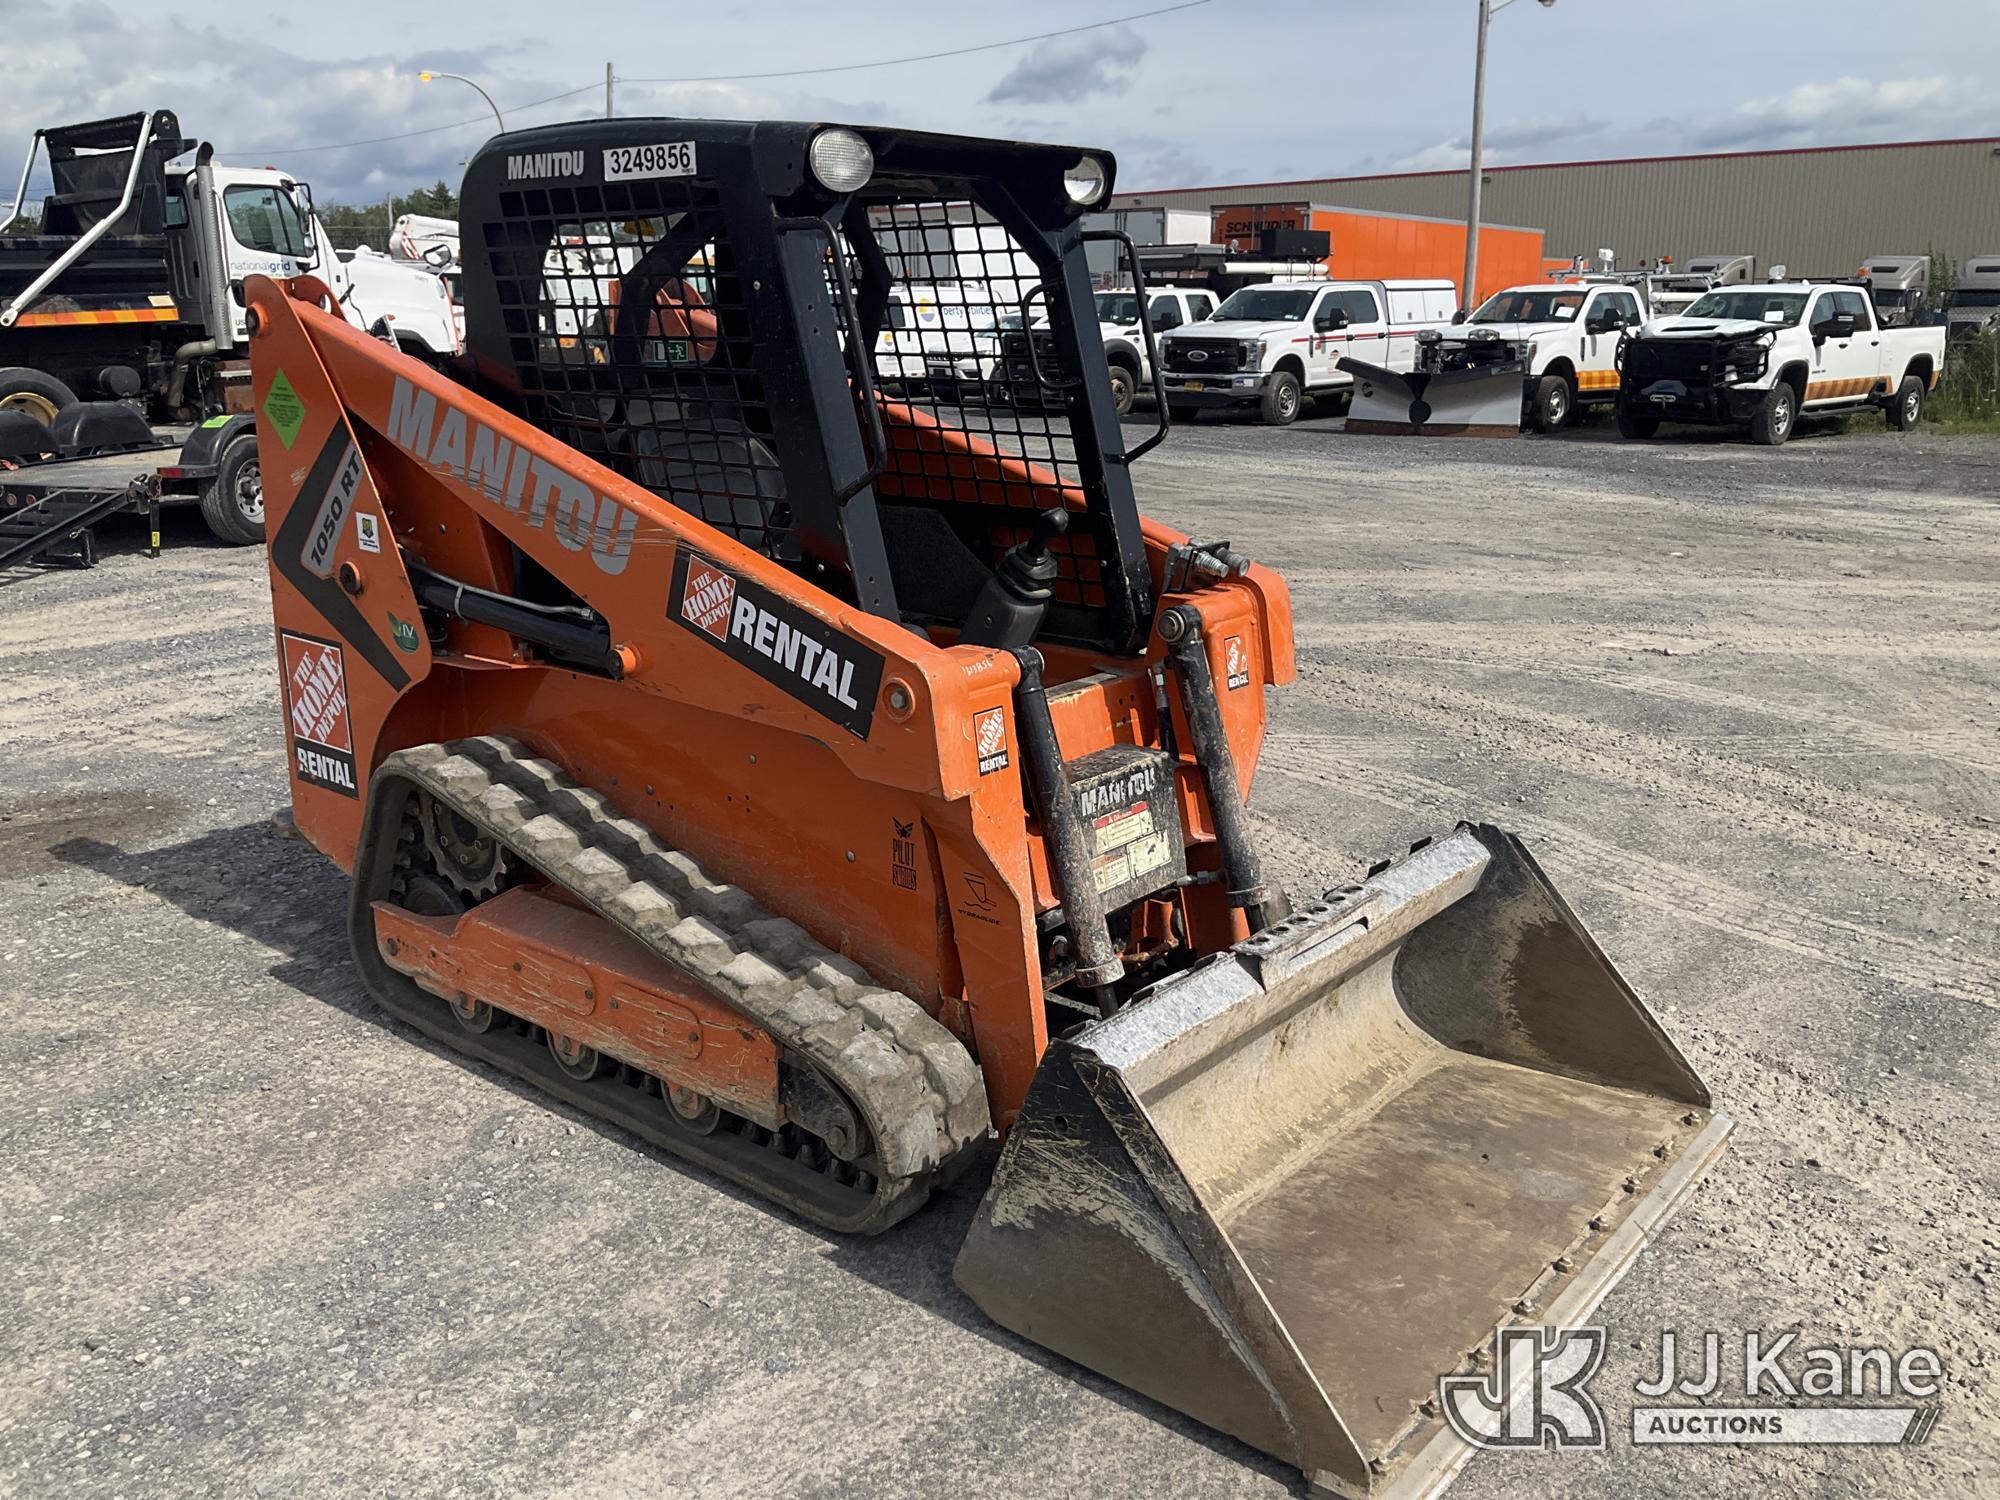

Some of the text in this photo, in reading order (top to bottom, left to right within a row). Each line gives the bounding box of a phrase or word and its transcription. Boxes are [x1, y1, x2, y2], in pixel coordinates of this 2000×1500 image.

[507, 150, 585, 180] MANITOU
[610, 143, 691, 174] 3249856
[230, 259, 291, 273] nationalgrid
[386, 373, 640, 577] MANITOU
[310, 449, 360, 567] 1050 RT
[683, 574, 735, 621] HOME
[691, 570, 712, 592] THE
[699, 600, 732, 629] DEPOT
[292, 650, 316, 690] THE
[731, 595, 858, 711] RENTAL
[292, 646, 344, 739] HOME
[314, 686, 346, 743] DEPOT
[296, 747, 356, 790] RENTAL
[980, 753, 1008, 773] RENTAL
[1081, 767, 1155, 816] MANITOU
